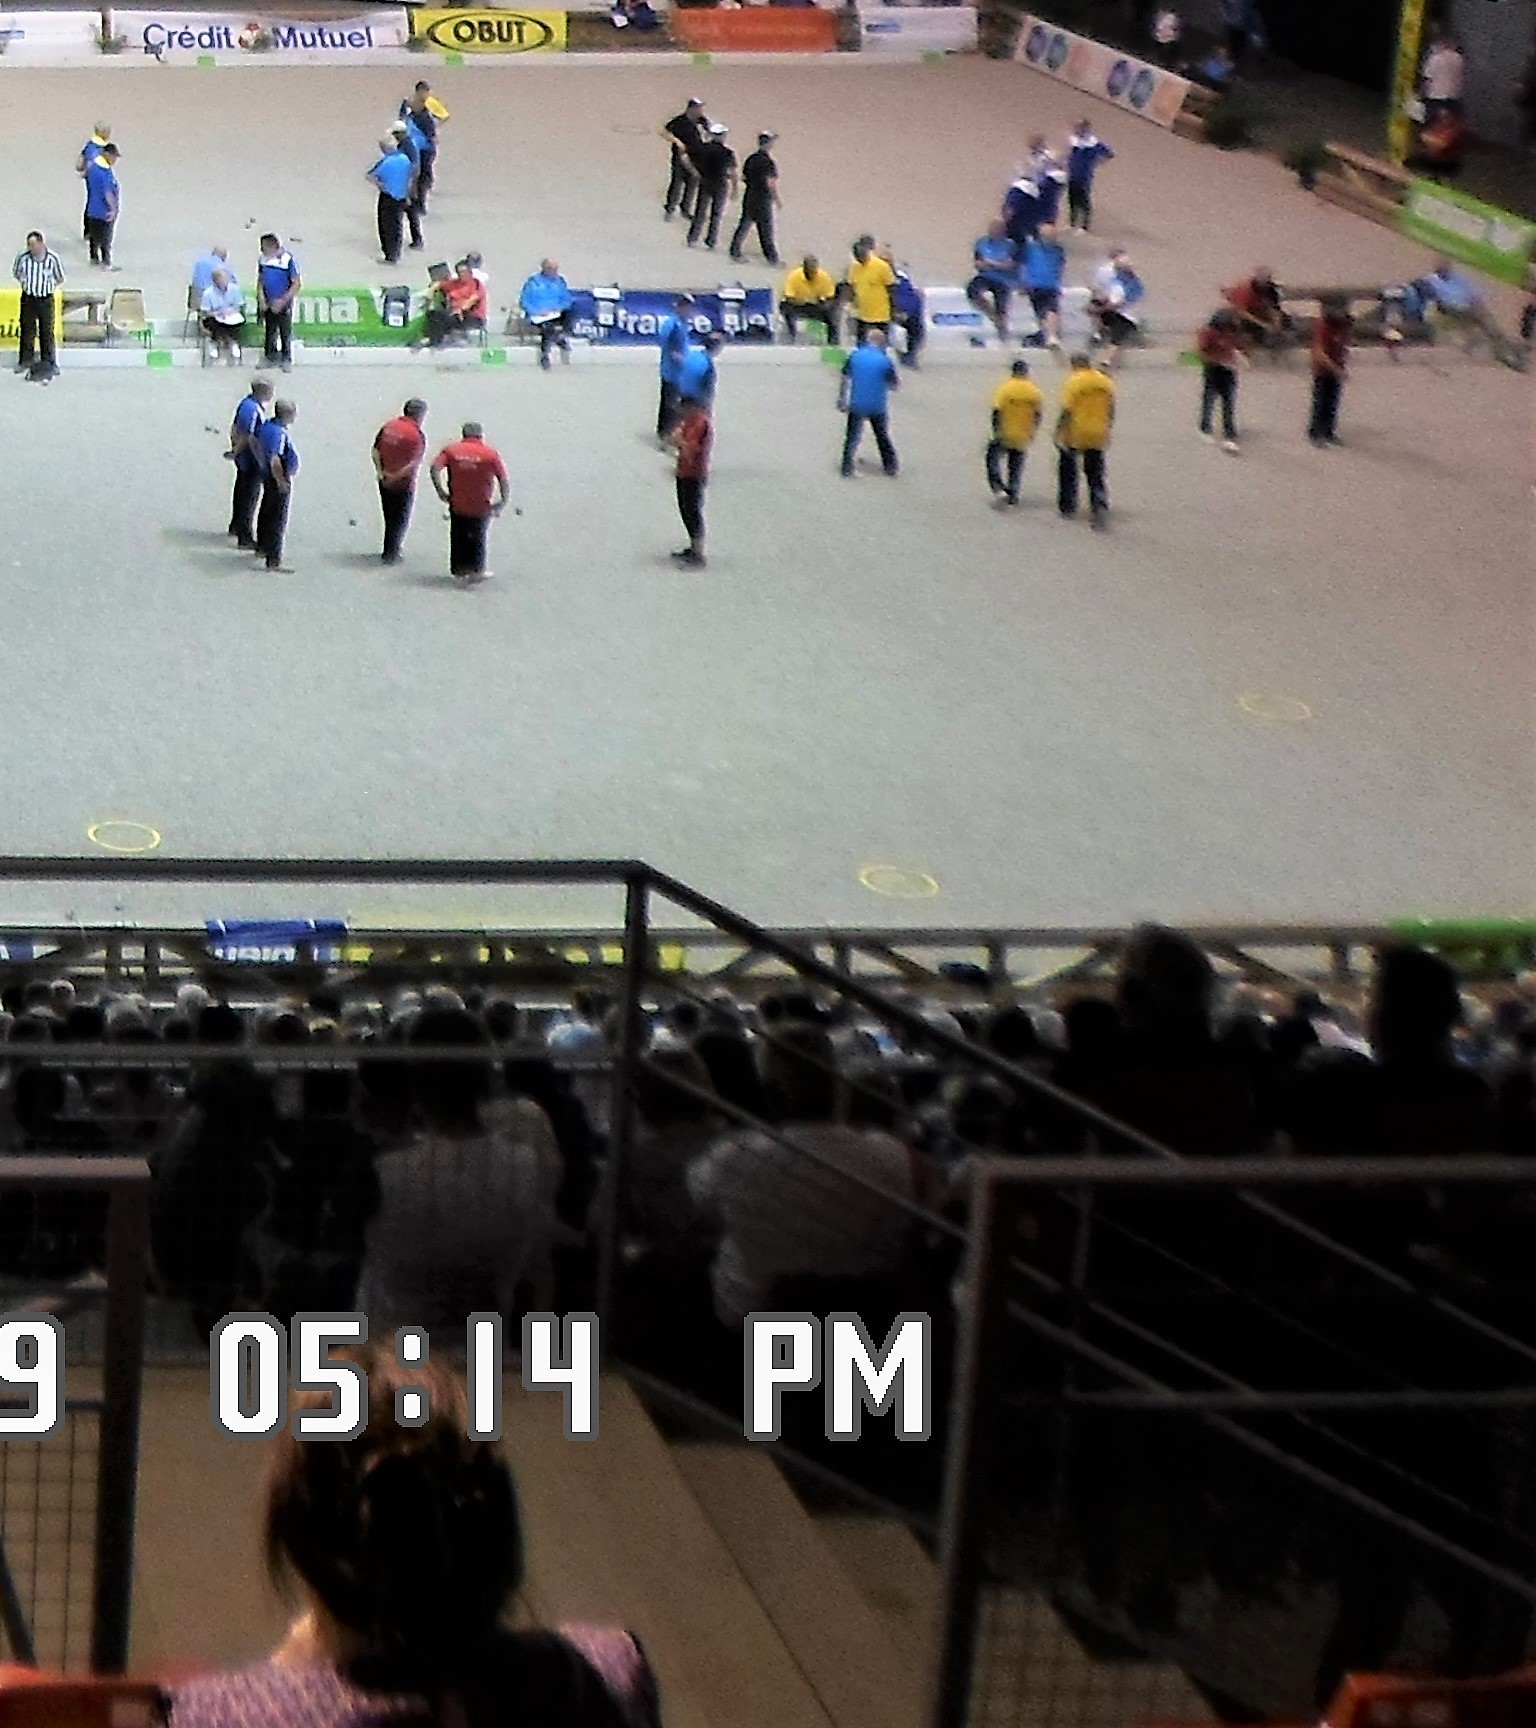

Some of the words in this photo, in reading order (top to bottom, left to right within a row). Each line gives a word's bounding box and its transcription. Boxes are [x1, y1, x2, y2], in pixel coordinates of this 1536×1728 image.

[143, 23, 235, 49] Crédit
[272, 26, 373, 48] Mutuel
[453, 19, 527, 43] OBUT
